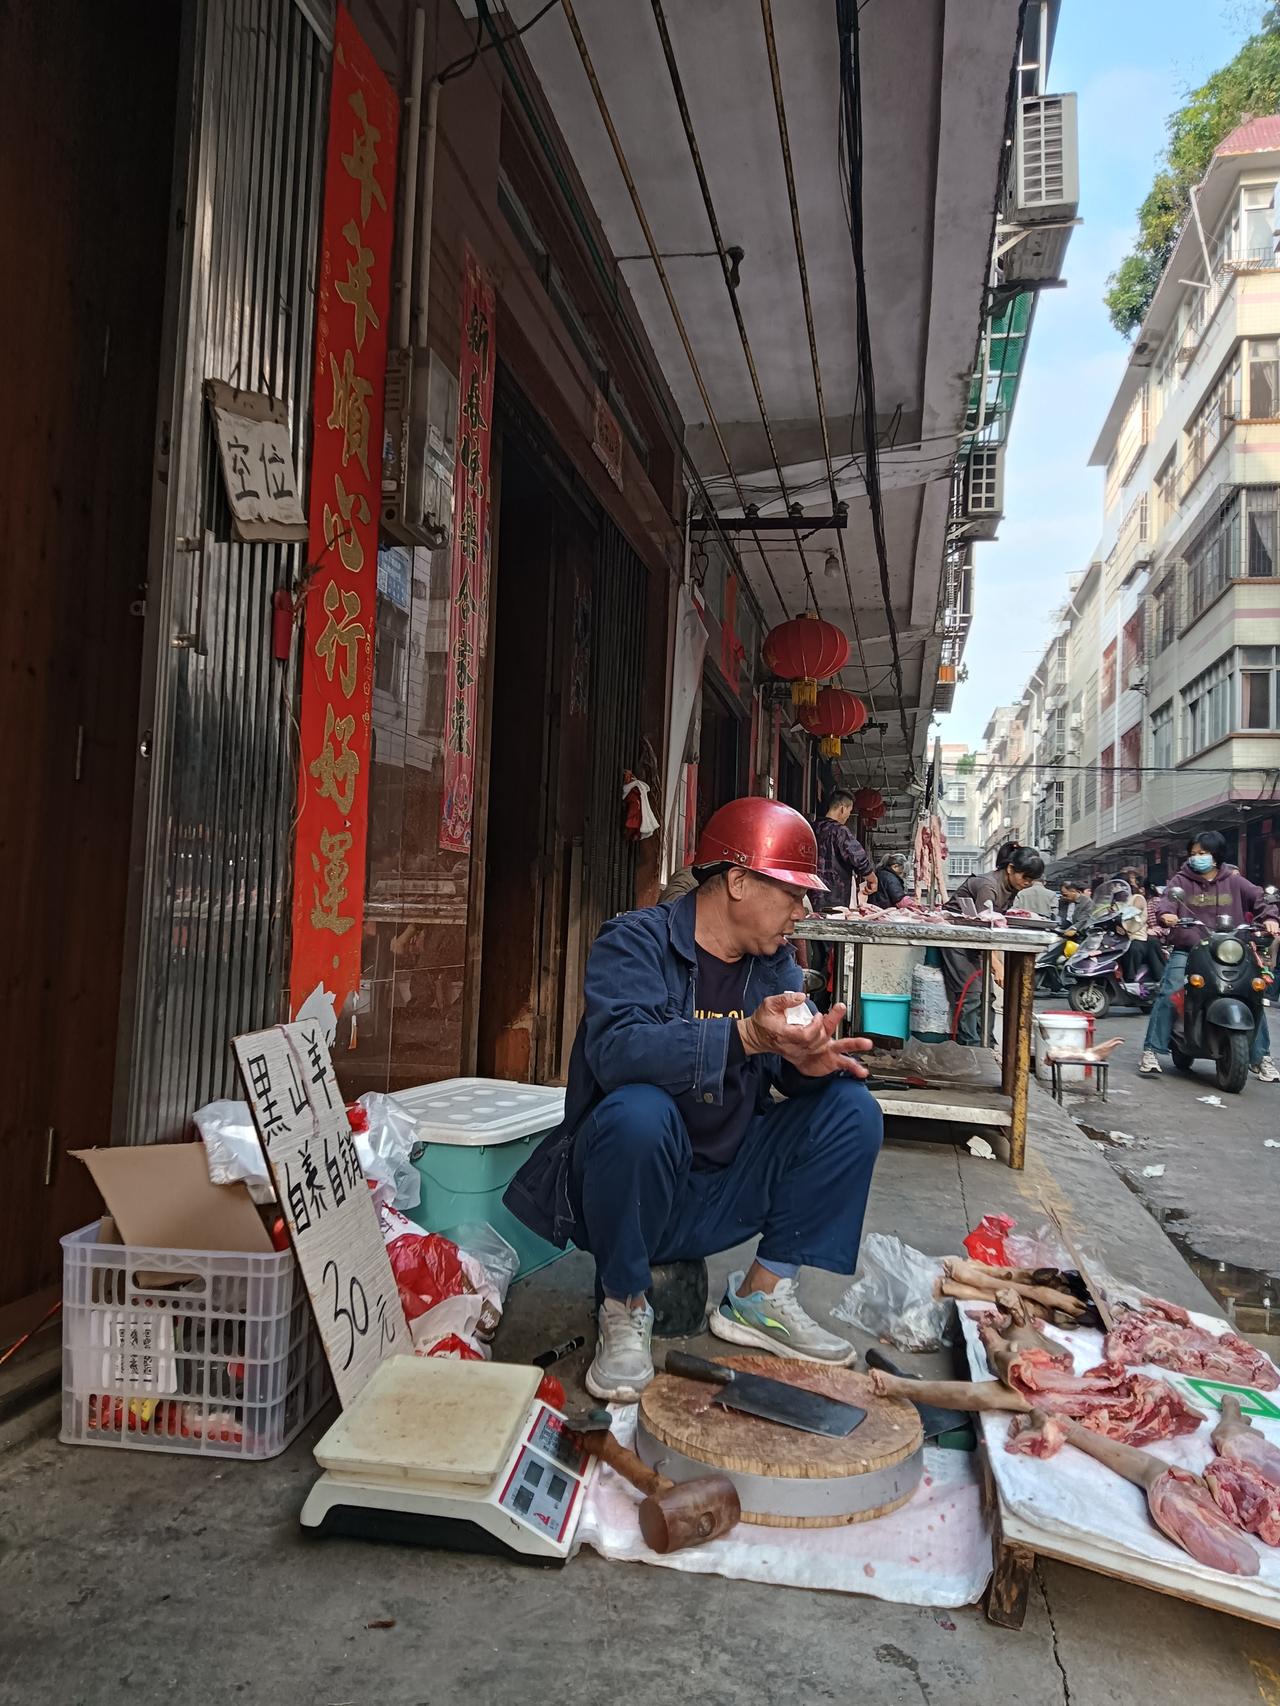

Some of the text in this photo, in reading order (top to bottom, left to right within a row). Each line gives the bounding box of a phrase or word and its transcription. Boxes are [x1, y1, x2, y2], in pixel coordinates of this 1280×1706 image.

[227, 436, 294, 500] 空位
[247, 1029, 334, 1146] 黑山羊
